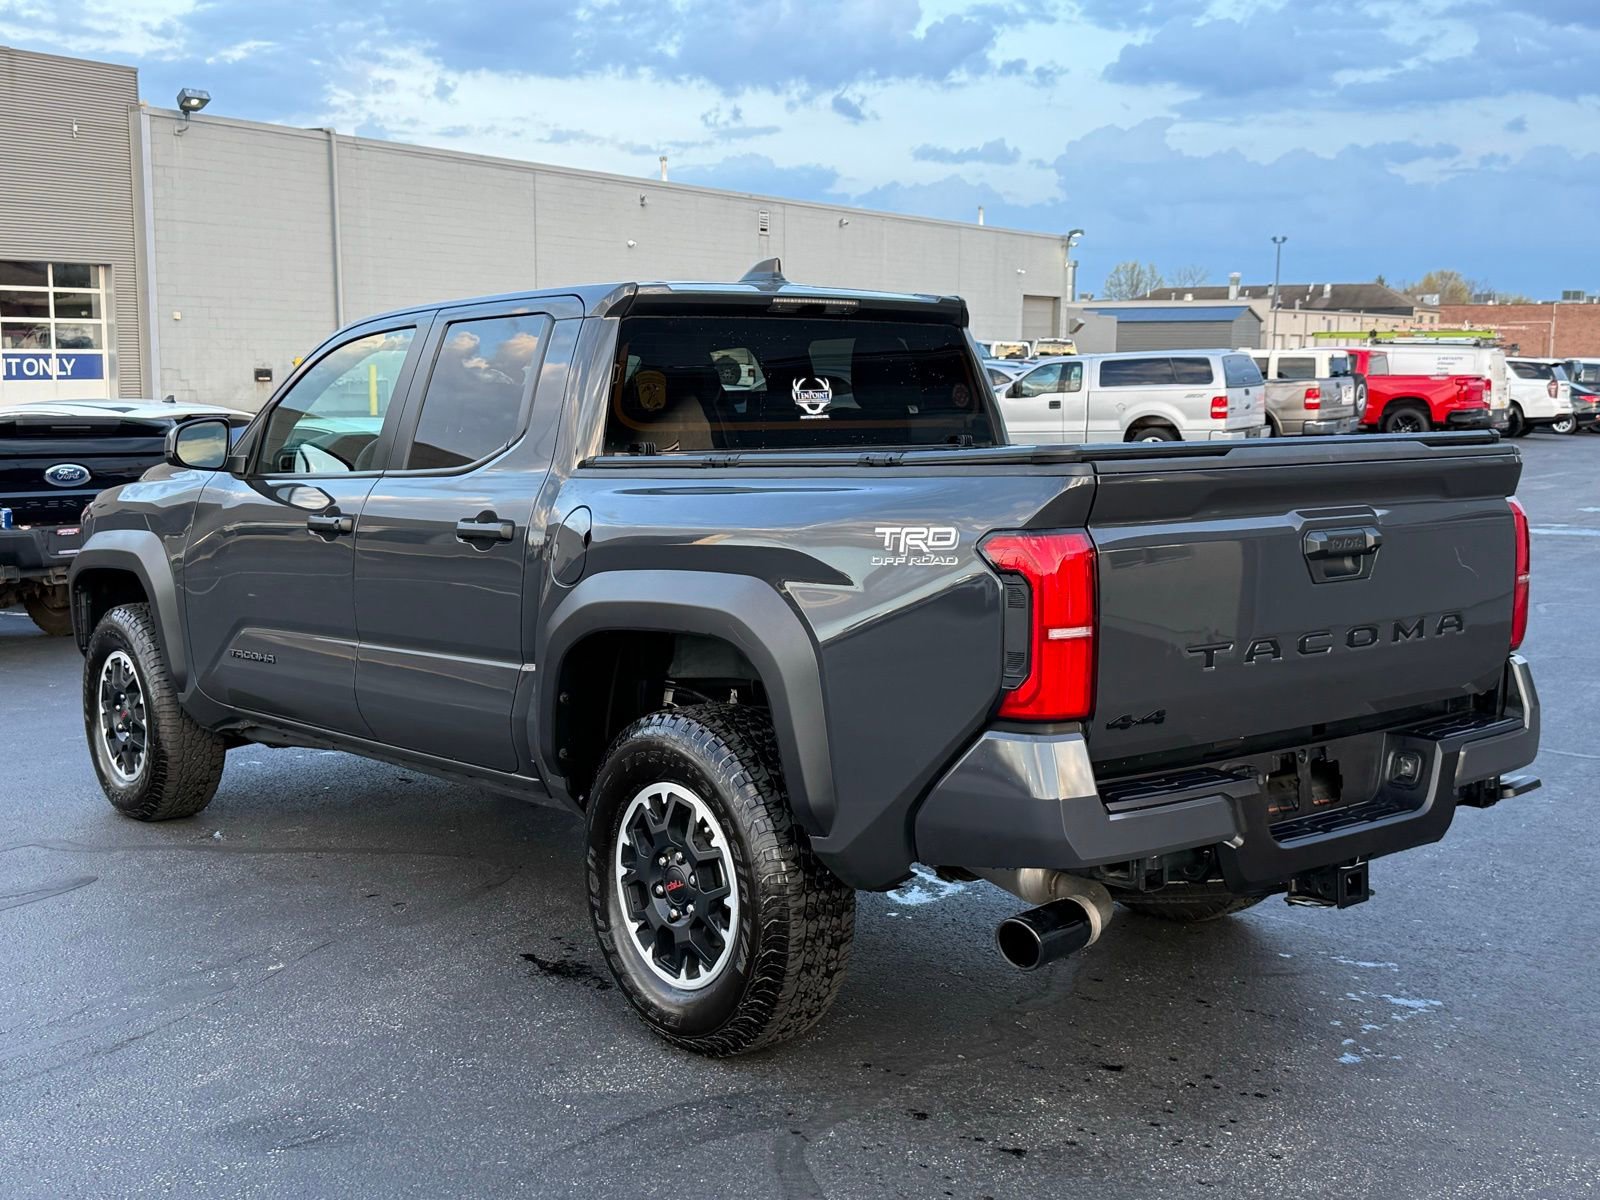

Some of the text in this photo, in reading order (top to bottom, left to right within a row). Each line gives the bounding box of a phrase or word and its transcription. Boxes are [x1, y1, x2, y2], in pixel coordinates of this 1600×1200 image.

[3, 357, 76, 376] T ONLY
[57, 468, 80, 480] Ford
[874, 526, 960, 556] TRD
[871, 555, 959, 566] OFF ROAD
[1185, 611, 1466, 672] TACOMA
[229, 648, 276, 664] TACOMA
